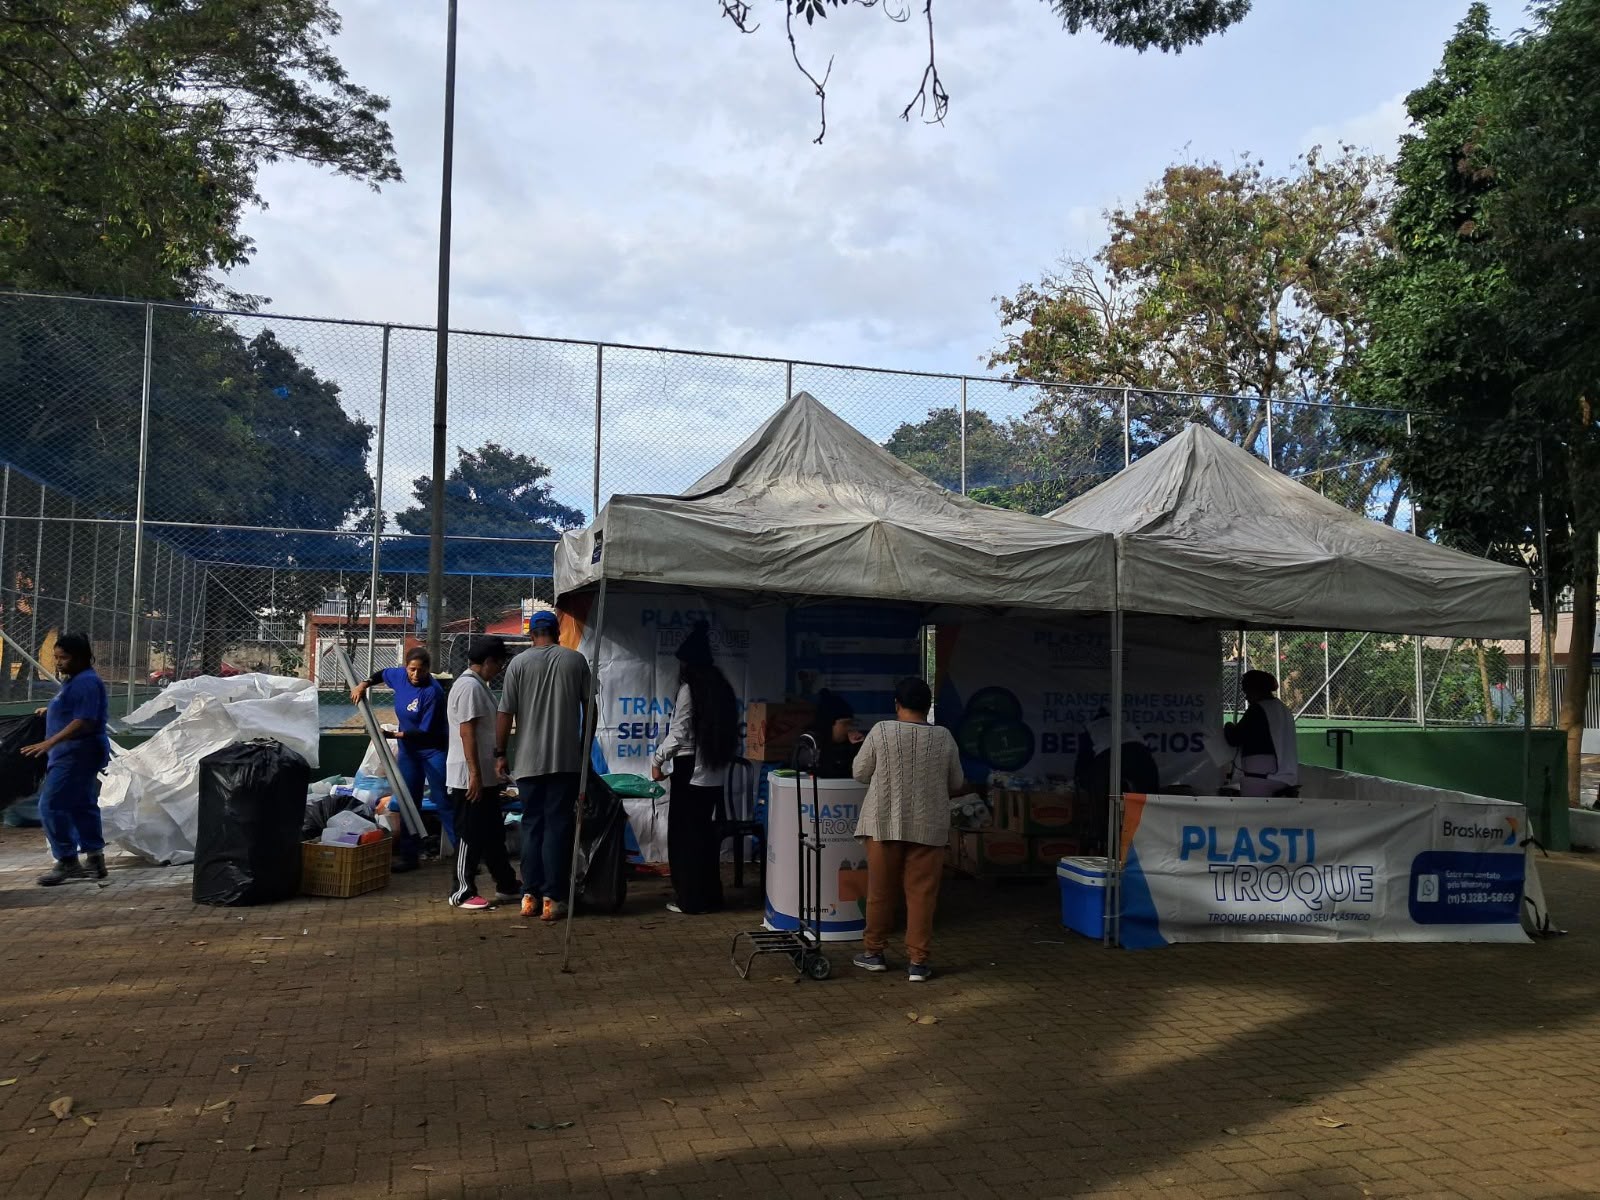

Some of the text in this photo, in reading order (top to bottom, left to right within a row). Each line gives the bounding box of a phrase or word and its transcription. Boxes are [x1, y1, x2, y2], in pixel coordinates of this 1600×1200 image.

[656, 629, 751, 651] TRQUE
[1043, 691, 1205, 707] TRANSFRME SUAS
[1180, 711, 1204, 723] EM
[617, 722, 659, 740] SEU
[617, 744, 641, 758] EM
[1041, 732, 1205, 754] BECIOS
[1443, 821, 1504, 839] Braskem
[1180, 825, 1316, 863] PLASTI
[1209, 864, 1374, 910] TROQUE
[1208, 913, 1247, 923] TROQUE
[1248, 913, 1256, 922] O
[1258, 913, 1298, 923] DESTINO
[1299, 913, 1312, 922] DO
[1313, 913, 1329, 922] SEU
